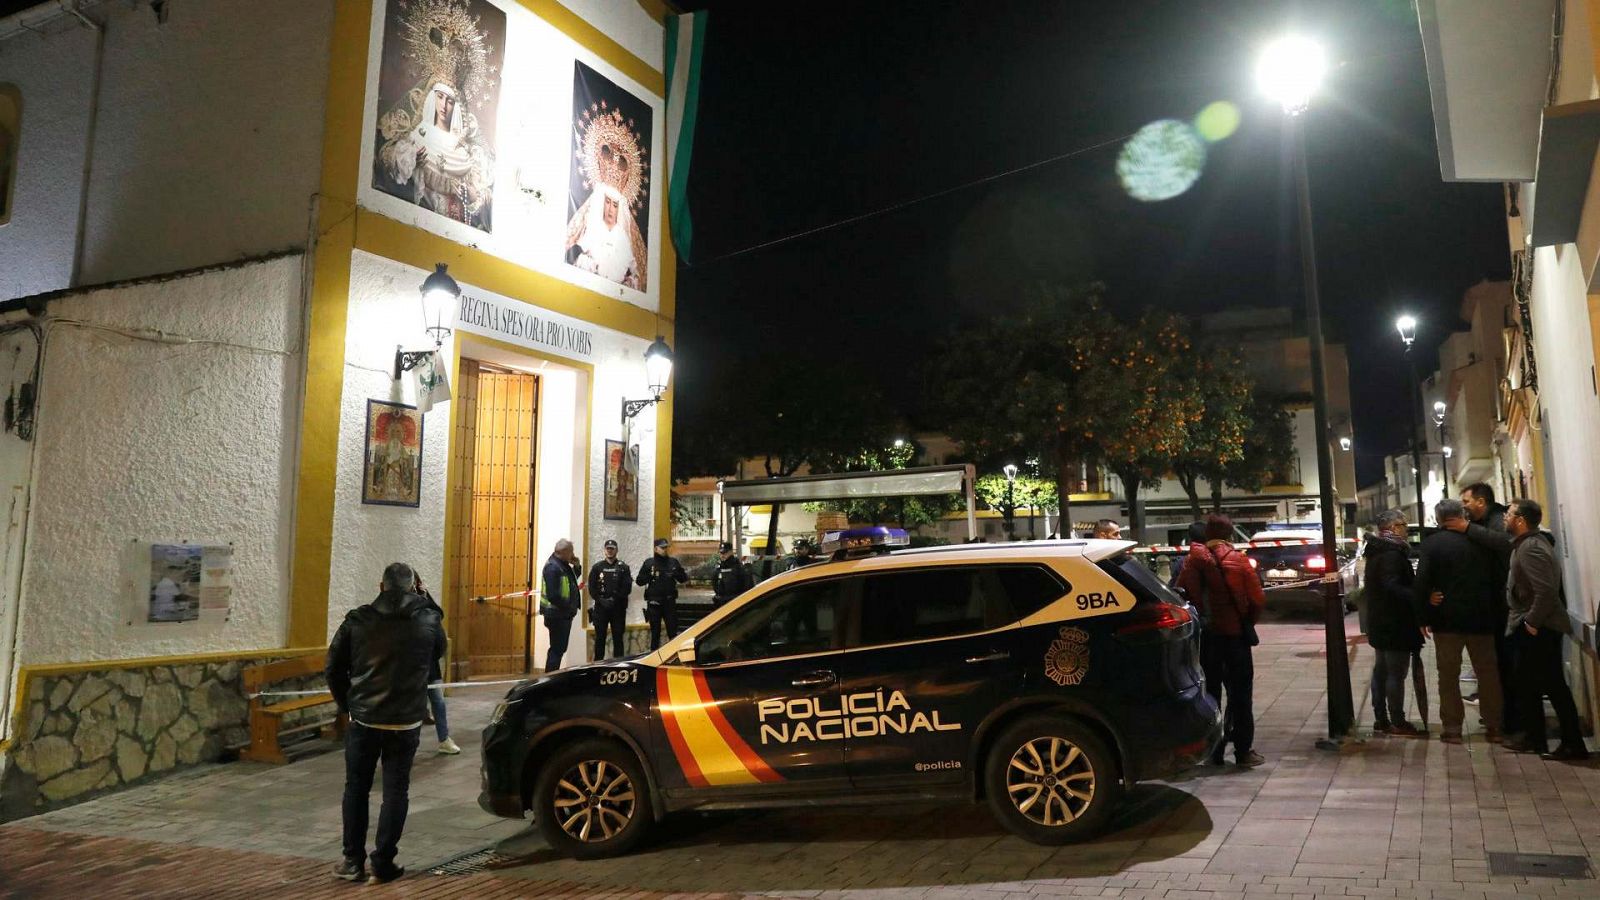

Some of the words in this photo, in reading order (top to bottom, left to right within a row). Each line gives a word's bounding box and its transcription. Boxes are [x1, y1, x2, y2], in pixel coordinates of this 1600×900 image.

[460, 295, 499, 331] REGINA
[501, 306, 524, 338] SPES
[525, 314, 544, 343] ORA
[546, 320, 565, 349] PRO
[565, 327, 593, 357] NOBIS
[1076, 591, 1120, 610] 9BA
[758, 686, 911, 722] POLICÍA
[759, 710, 962, 745] NACIONAL
[914, 760, 962, 771] @policia
